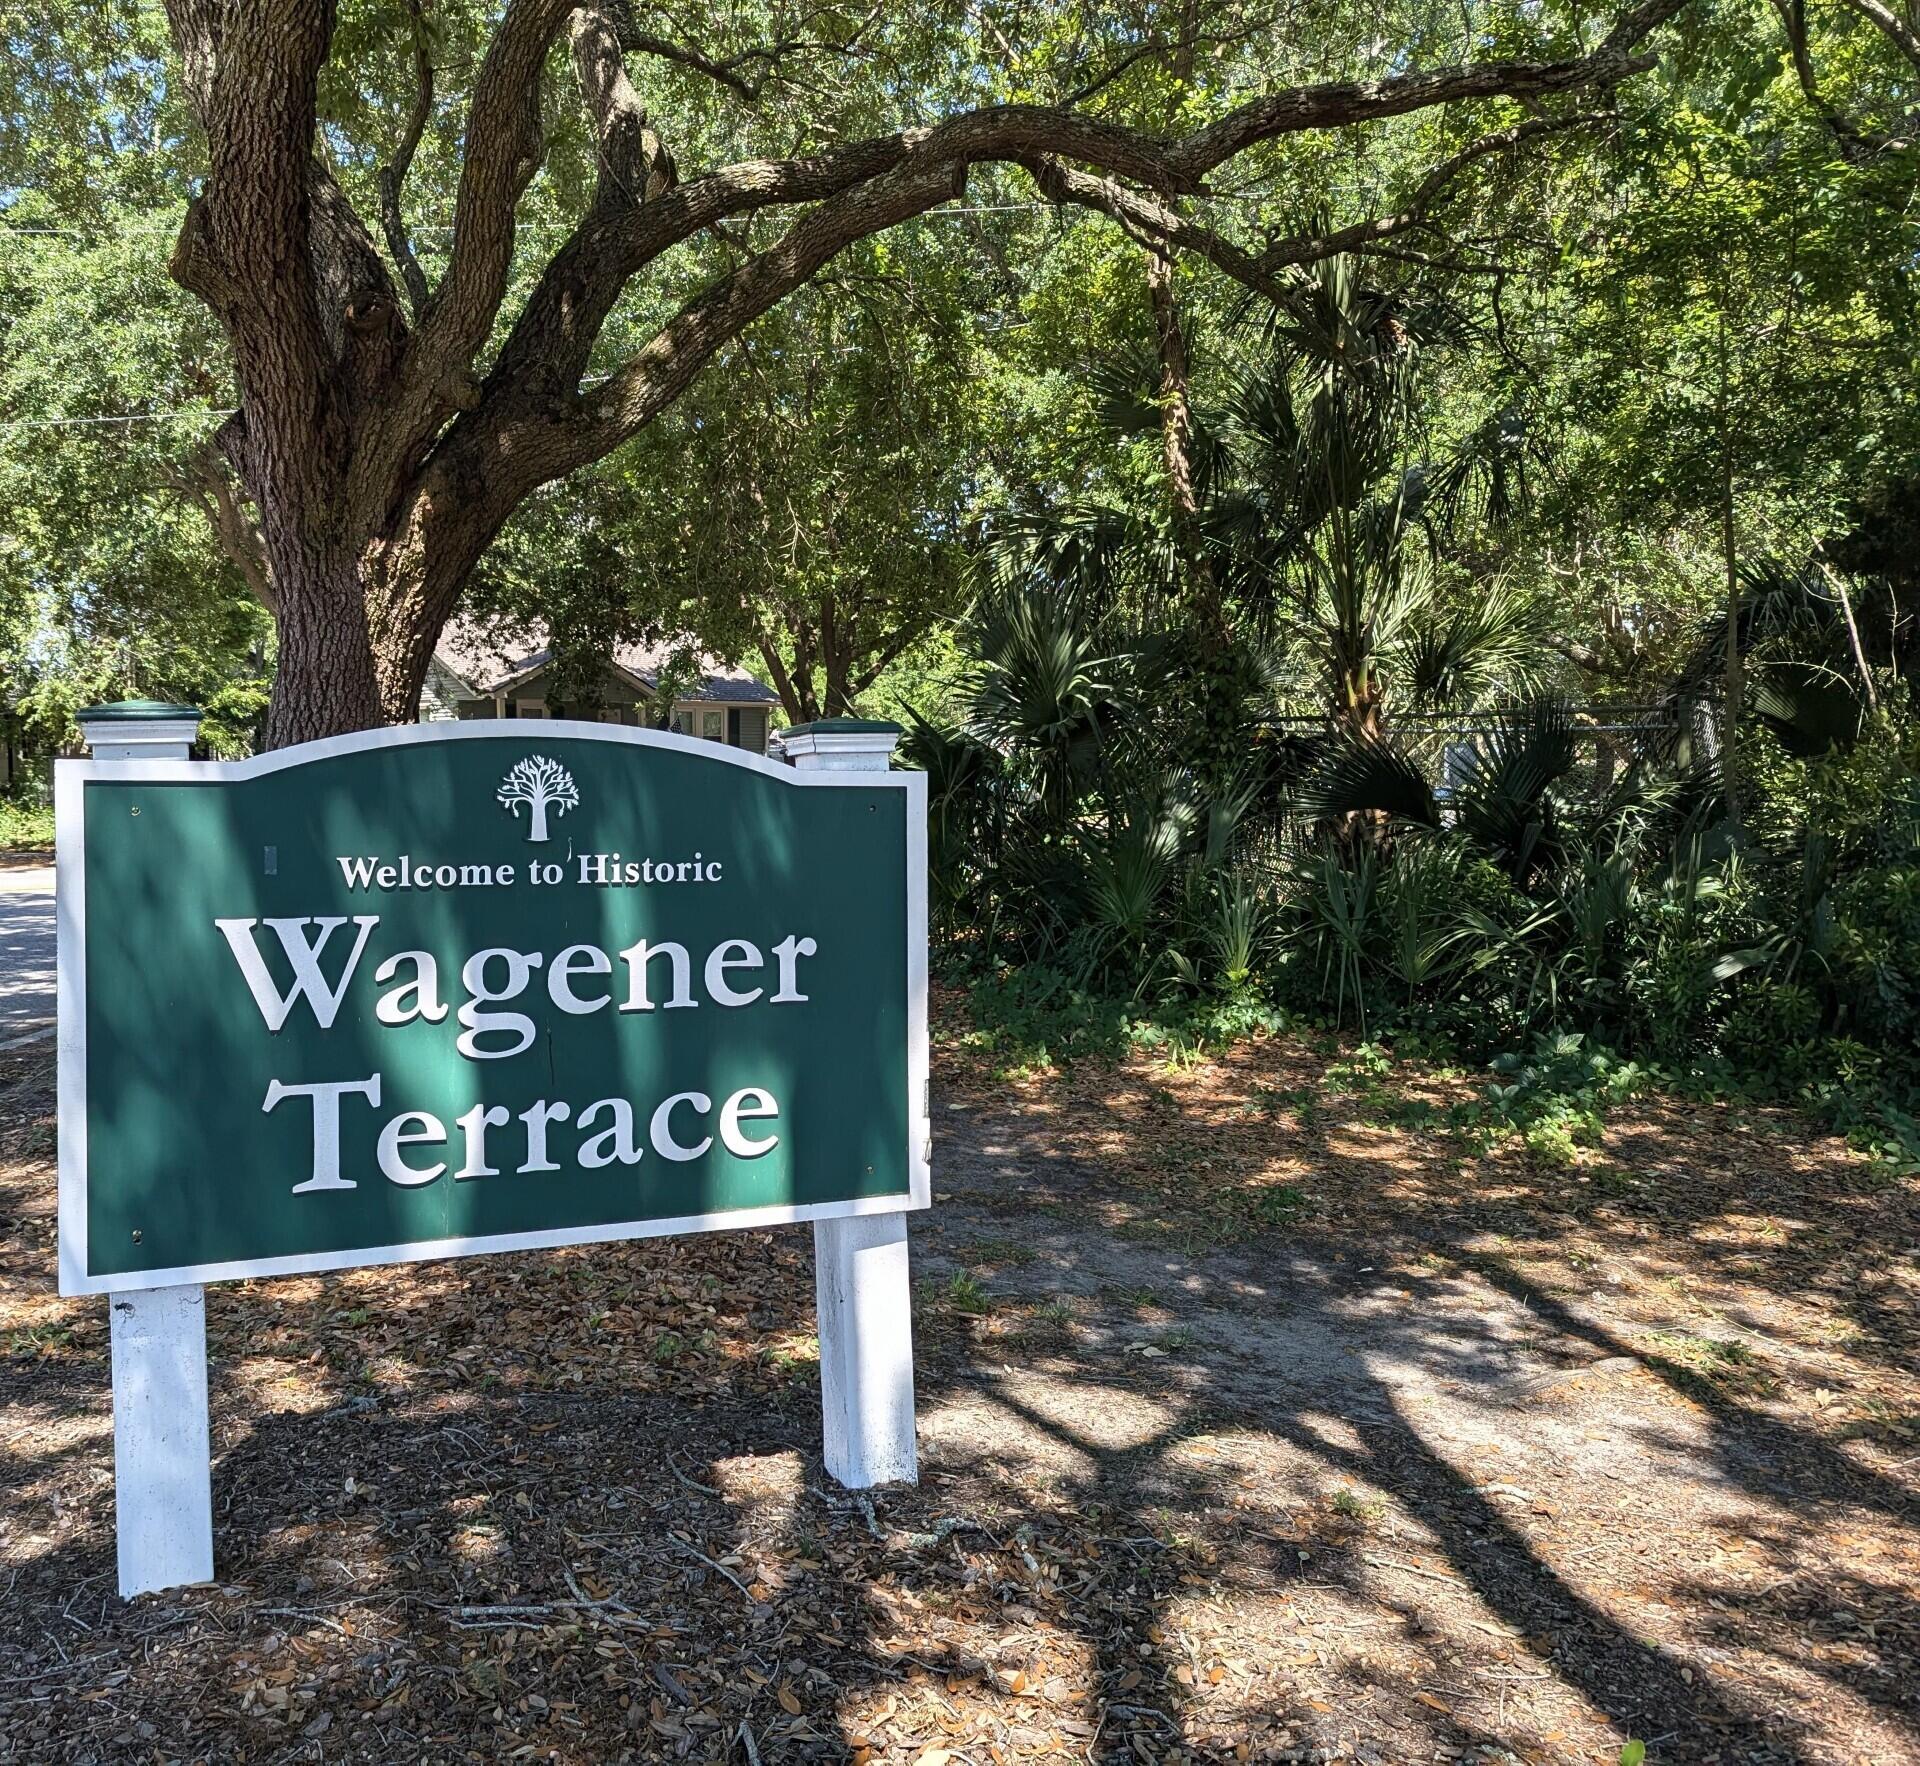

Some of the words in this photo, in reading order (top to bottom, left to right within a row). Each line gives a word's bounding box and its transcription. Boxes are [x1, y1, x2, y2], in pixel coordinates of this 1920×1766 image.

[337, 856, 515, 888] Welcome
[528, 859, 565, 886] to
[577, 852, 723, 884] Historic
[214, 915, 818, 1061] Wagener
[261, 1072, 780, 1194] Terrace
